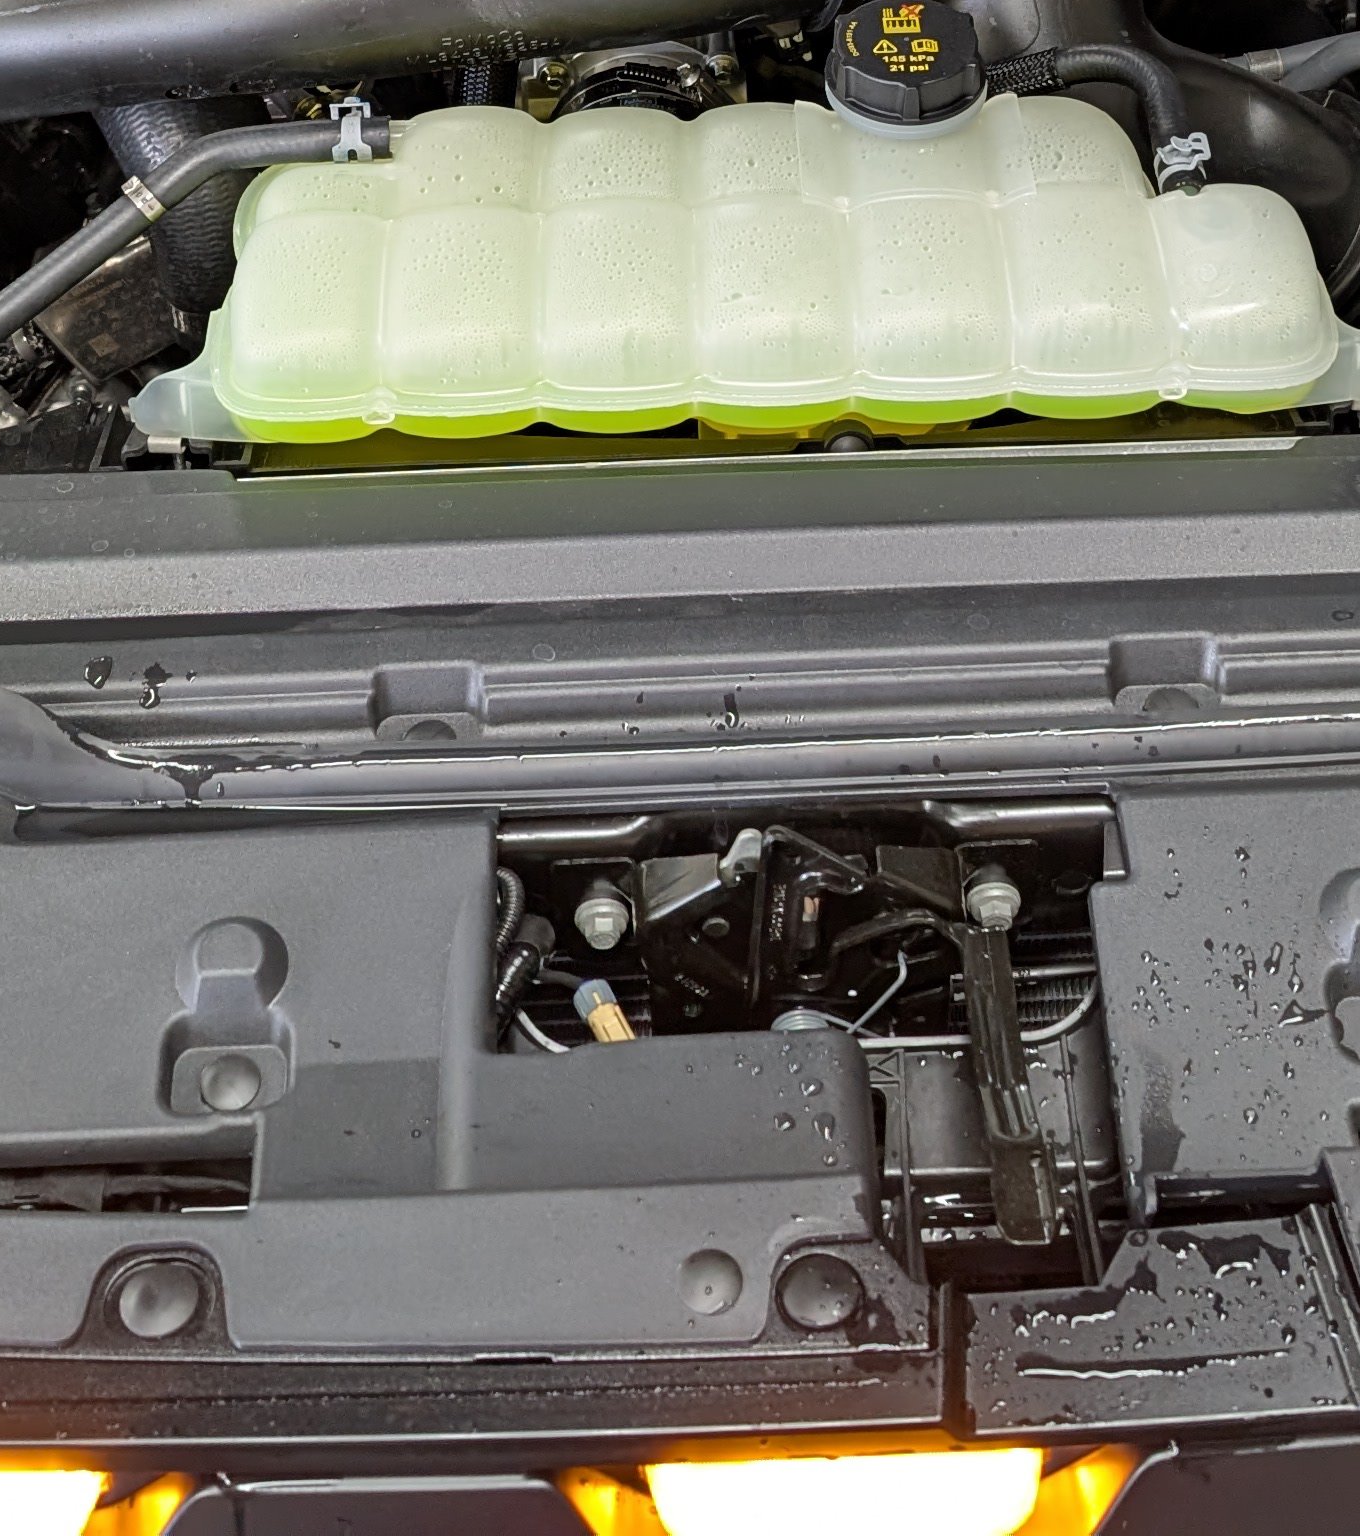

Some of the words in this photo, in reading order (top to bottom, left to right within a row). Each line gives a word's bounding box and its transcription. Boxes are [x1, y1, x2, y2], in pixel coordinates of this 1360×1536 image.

[882, 55, 905, 63] 145
[889, 64, 905, 72] 21
[909, 64, 929, 72] psi
